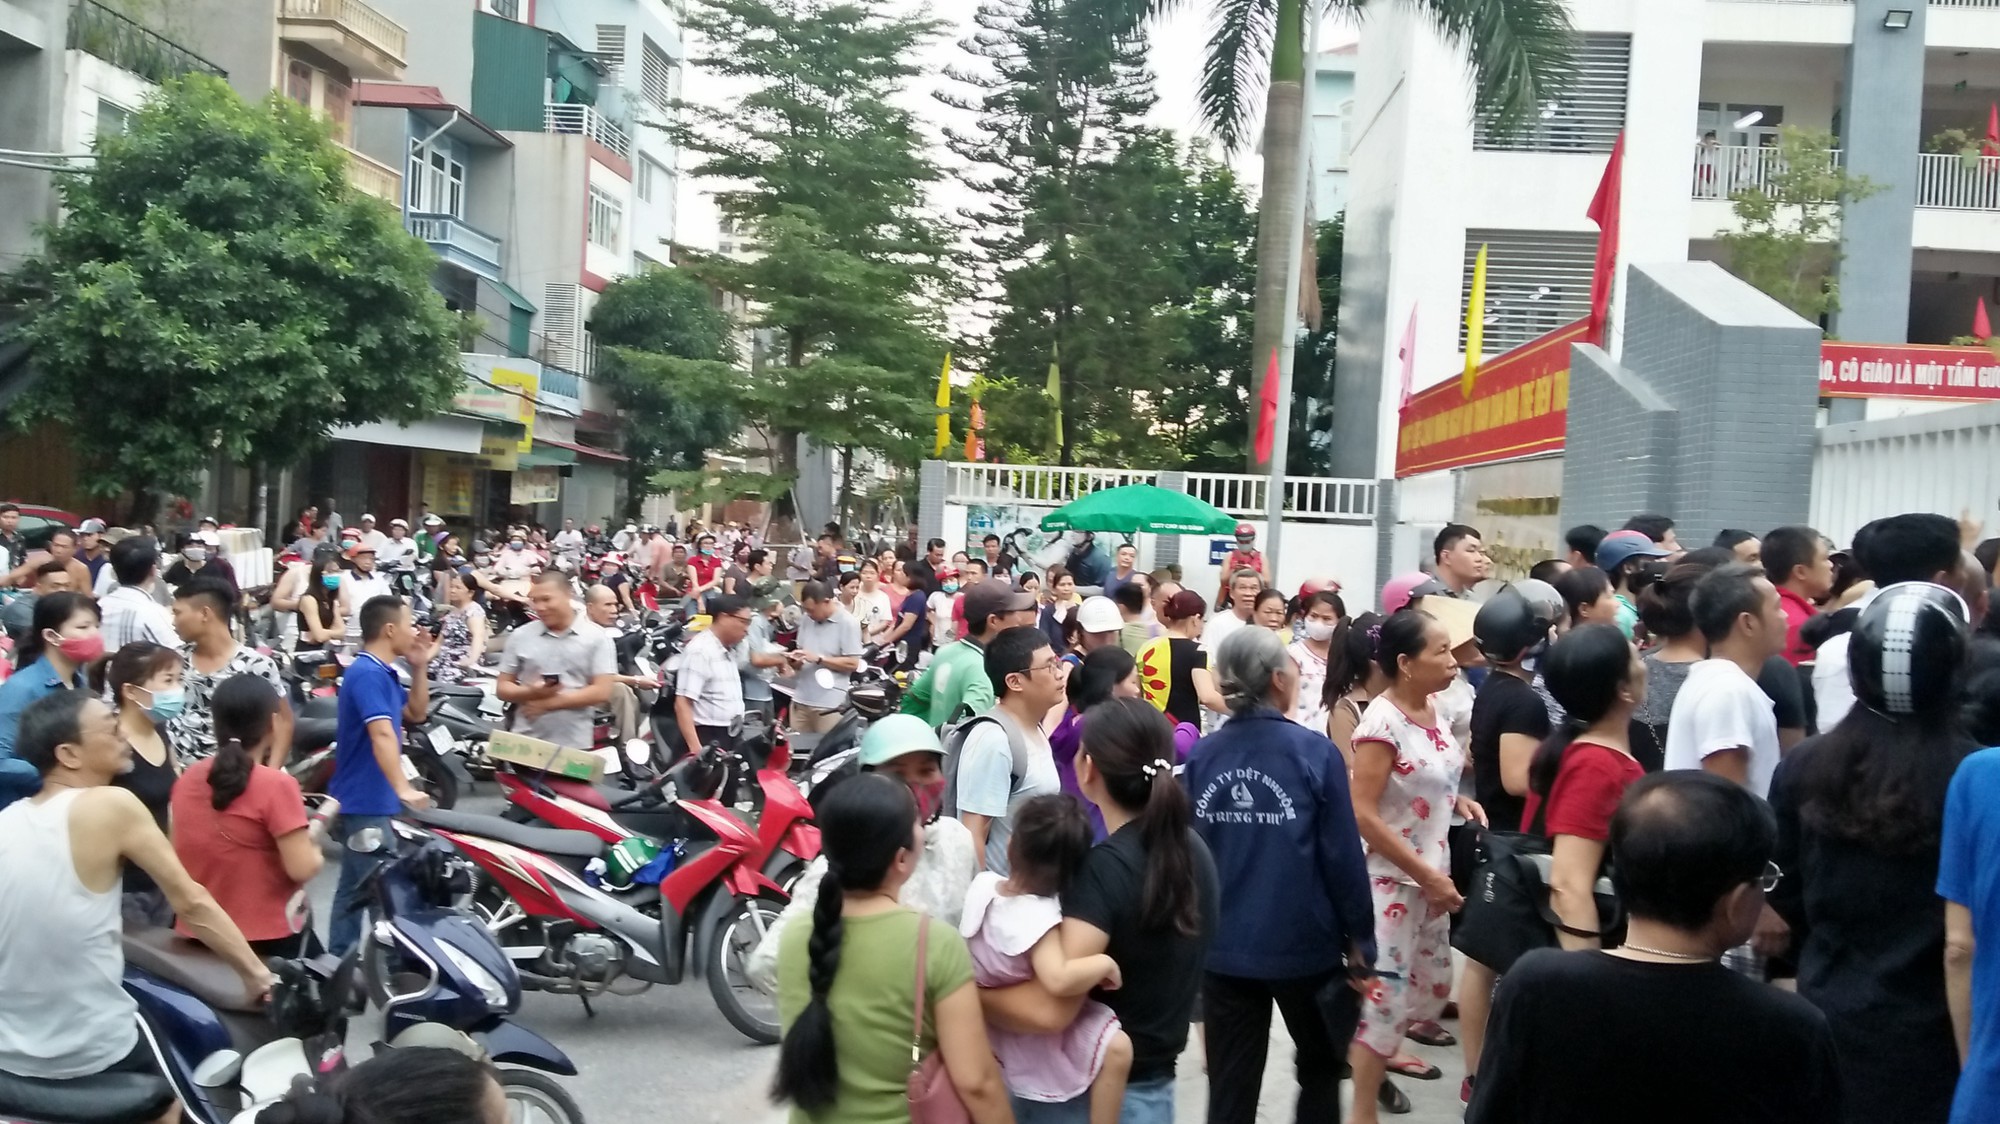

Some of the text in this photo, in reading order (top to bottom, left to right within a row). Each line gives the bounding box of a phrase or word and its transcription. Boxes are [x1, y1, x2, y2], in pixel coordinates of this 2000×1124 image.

[1839, 356, 1859, 383] CÔ
[1860, 358, 1893, 384] GIÁO
[1895, 359, 1913, 385] LÀ
[1914, 360, 1945, 390] MỘT
[1947, 359, 1976, 387] TẤM
[1195, 766, 1297, 821] CÔNG TY DỆT NHUỘM
[1206, 811, 1252, 824] TRUNG
